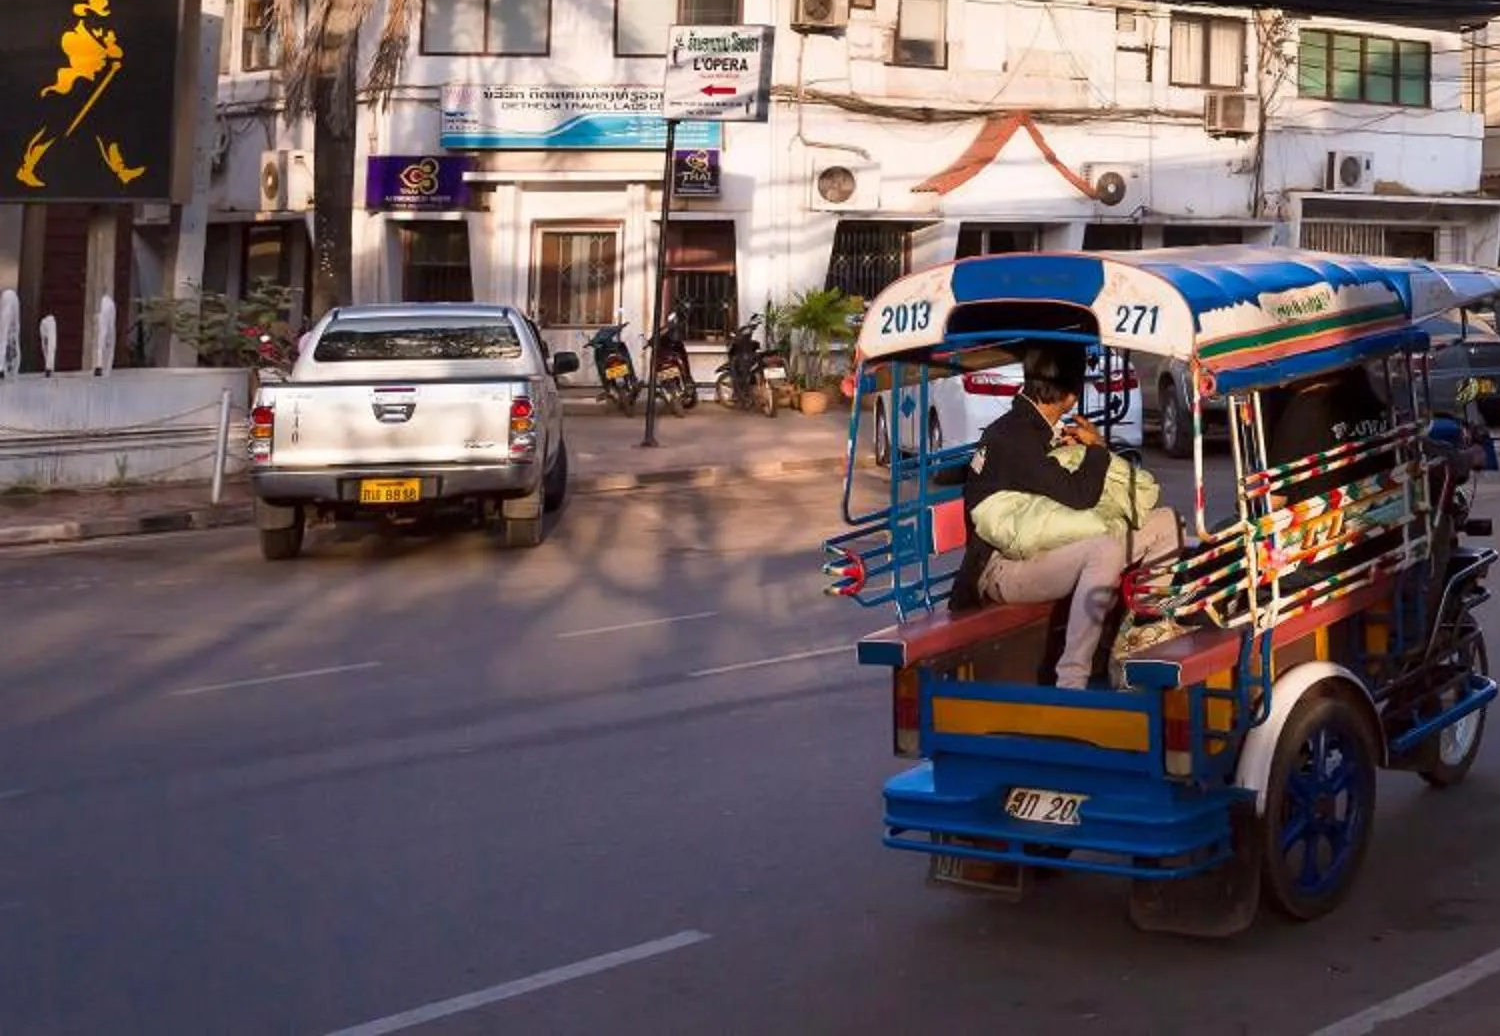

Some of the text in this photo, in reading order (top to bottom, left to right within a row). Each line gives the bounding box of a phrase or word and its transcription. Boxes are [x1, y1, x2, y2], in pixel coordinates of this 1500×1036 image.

[693, 58, 749, 71] L'OPERA
[501, 102, 561, 111] DIETHELM
[563, 102, 612, 111] TRAVEL
[881, 302, 932, 334] 2013
[1115, 305, 1160, 334] 271
